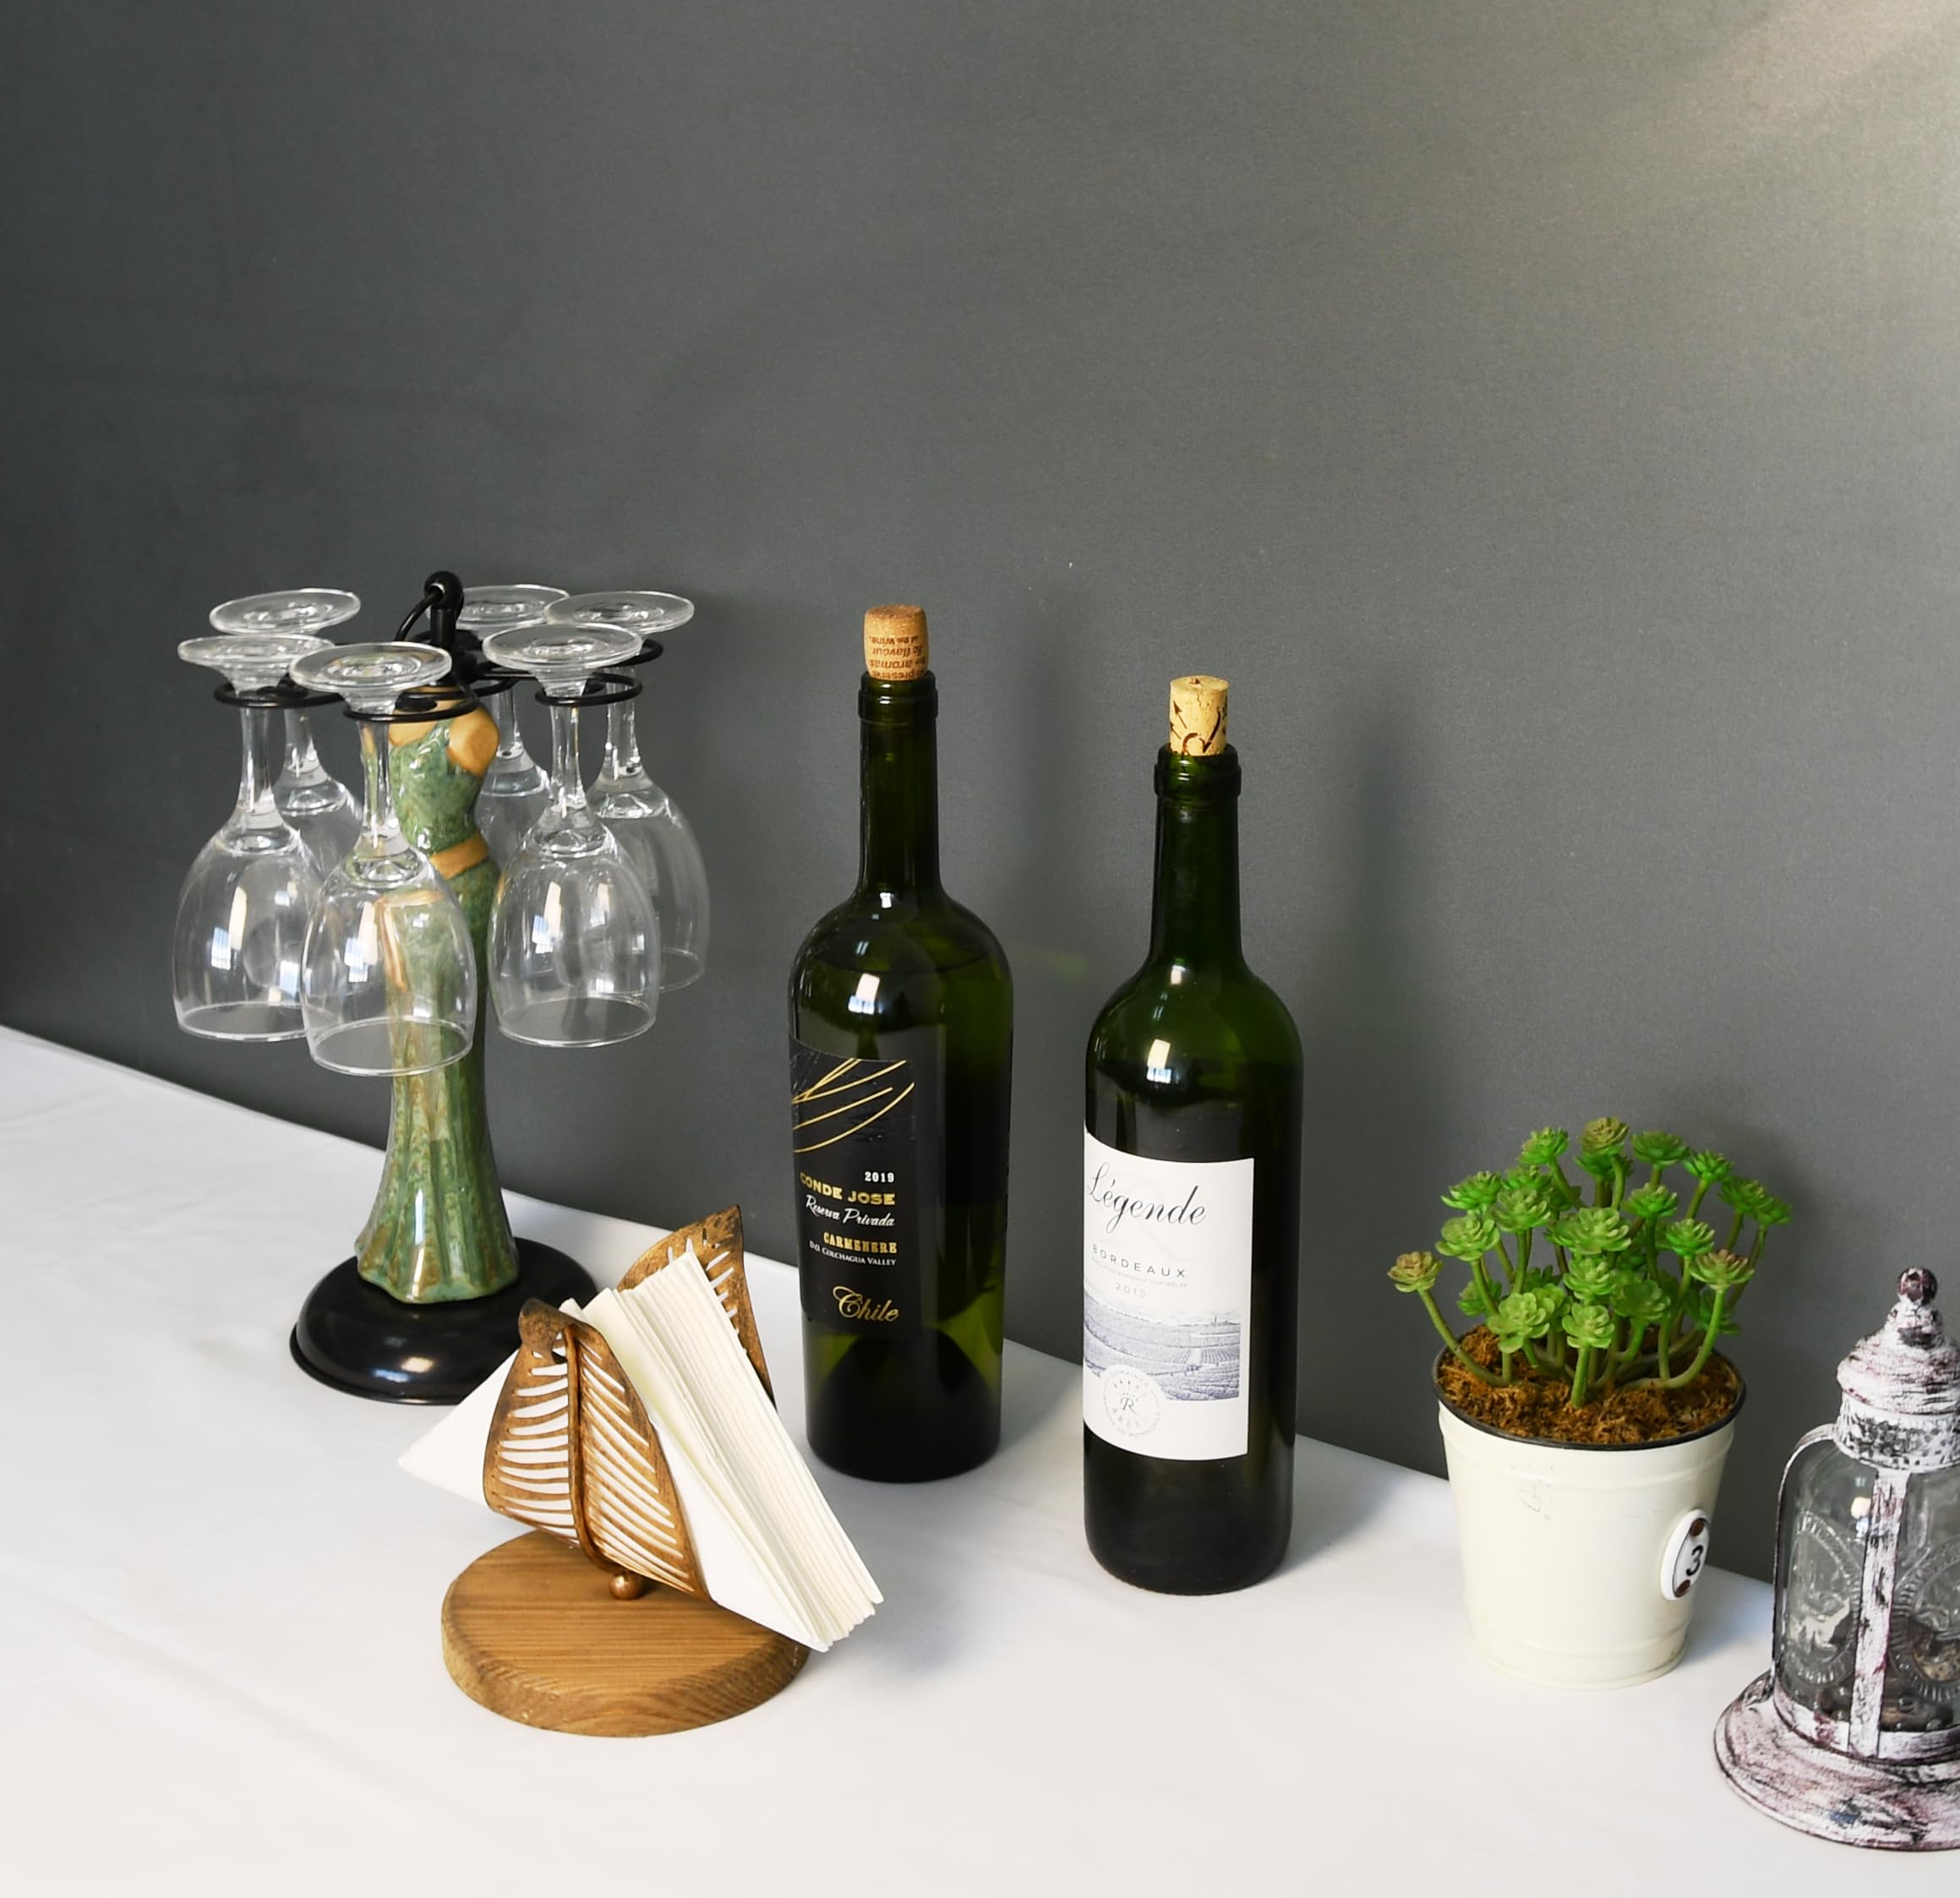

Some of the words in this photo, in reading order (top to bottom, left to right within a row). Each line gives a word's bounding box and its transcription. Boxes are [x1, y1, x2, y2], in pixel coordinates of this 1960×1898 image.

[870, 659, 913, 668] aromas
[872, 647, 911, 657] flavour
[800, 1172, 843, 1200] CONDE
[848, 1191, 895, 1205] JOSE
[865, 1171, 895, 1182] 2019
[805, 1194, 840, 1220] Reserva
[843, 1208, 895, 1226] Privada
[1089, 1162, 1207, 1234] Légende
[822, 1247, 865, 1263] COLCHAGUA
[867, 1257, 896, 1266] VALLEY
[823, 1231, 897, 1253] CARMENERE
[1092, 1244, 1187, 1278] BORDEAUX
[833, 1285, 899, 1322] Chile
[1685, 1544, 1704, 1577] 3
